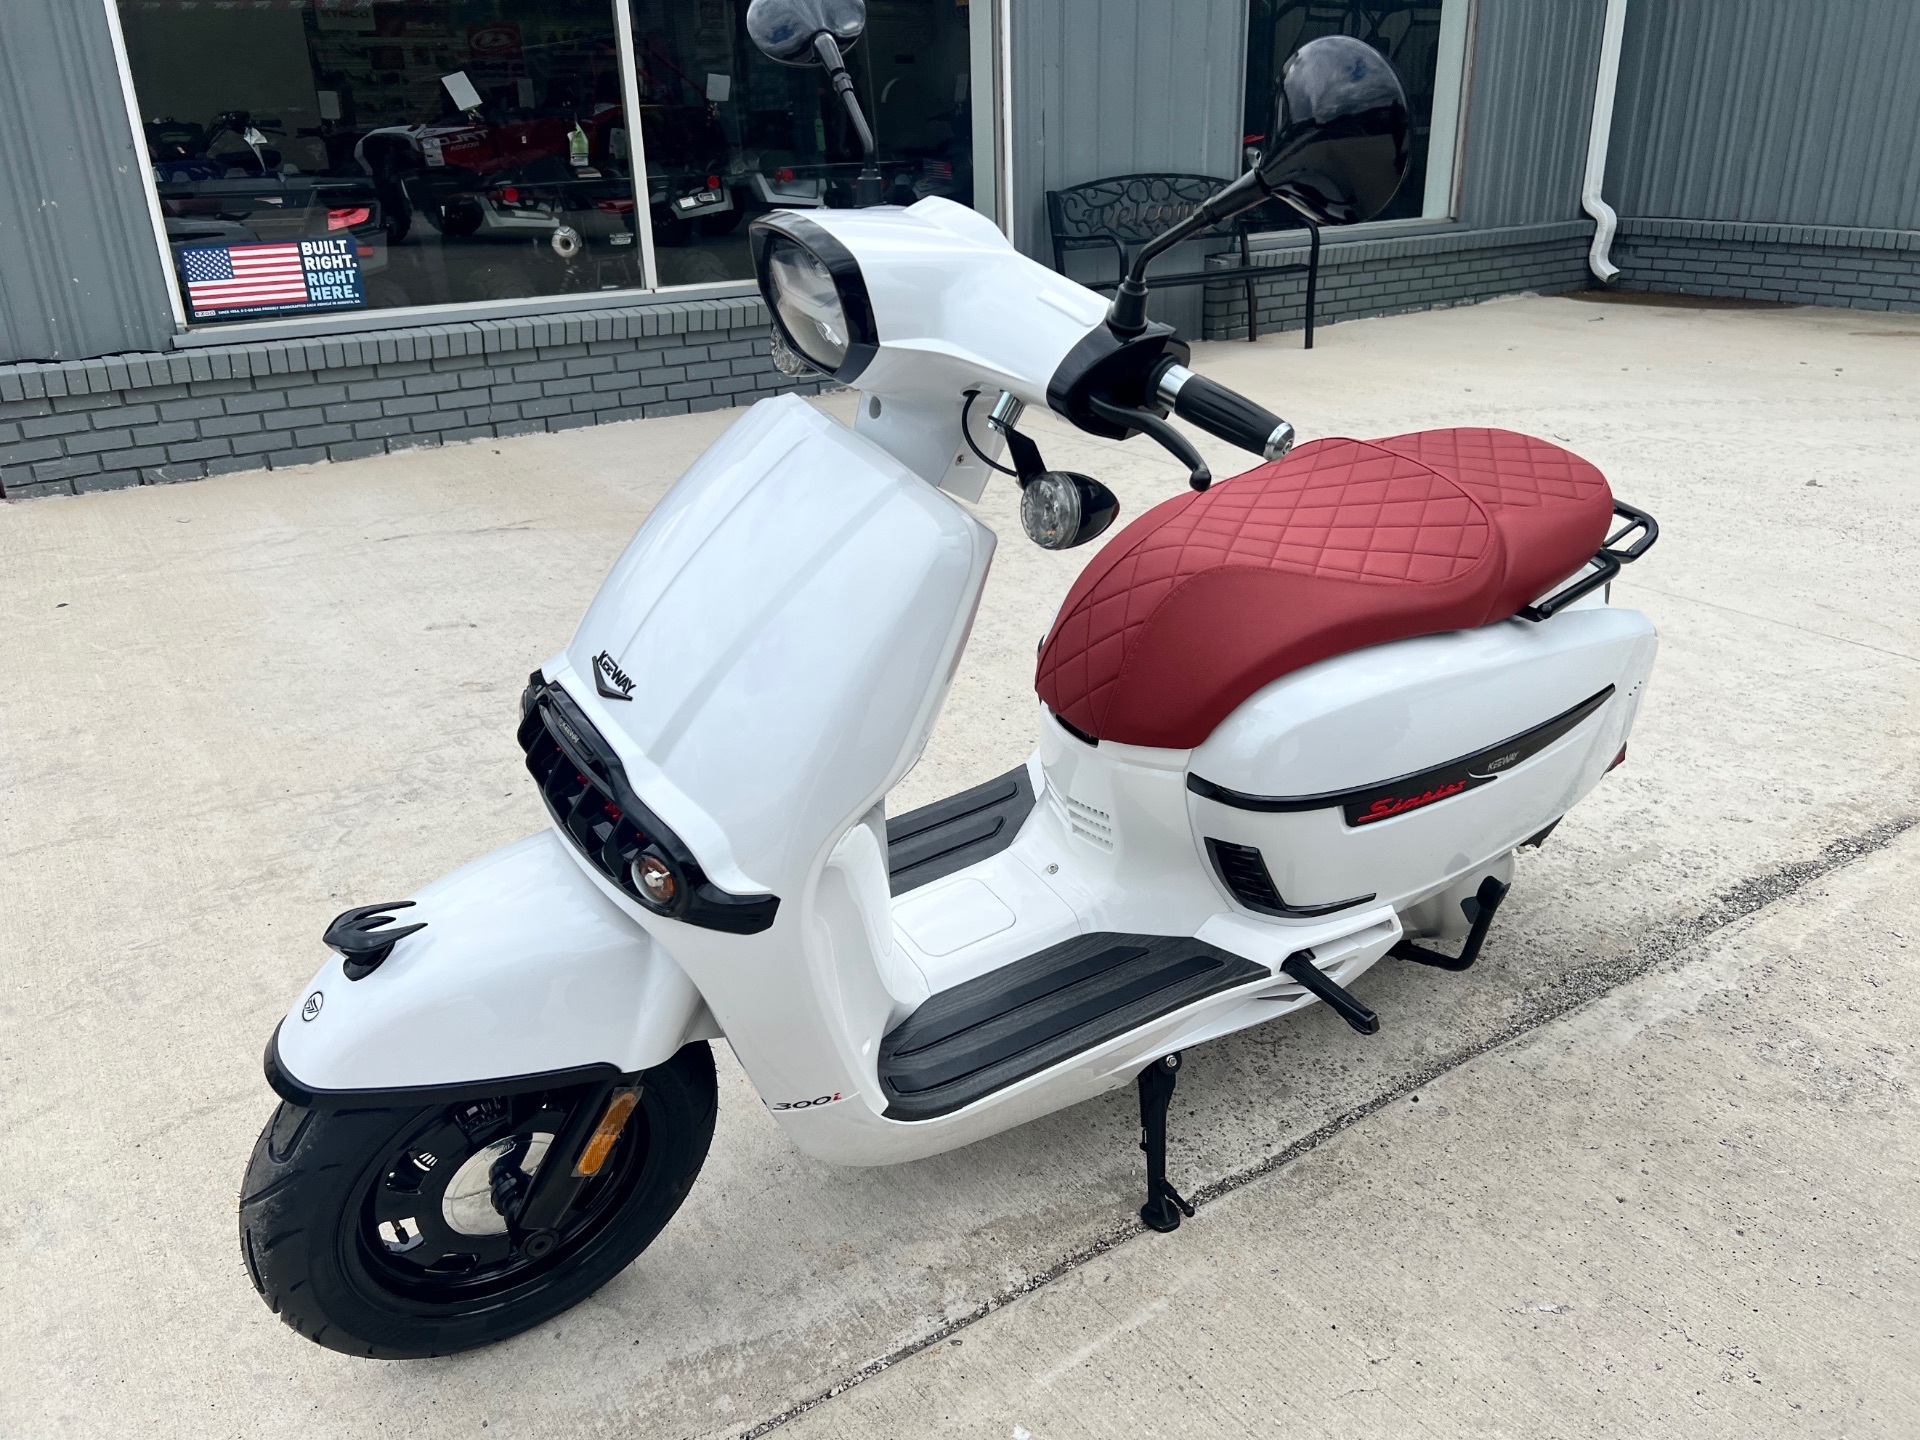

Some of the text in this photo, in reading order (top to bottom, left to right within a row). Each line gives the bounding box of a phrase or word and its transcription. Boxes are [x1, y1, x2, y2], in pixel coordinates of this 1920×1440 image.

[301, 239, 347, 256] BUILT
[303, 254, 357, 271] RIGHT.
[307, 269, 356, 286] RIGHT
[310, 284, 360, 301] HERE.
[1487, 751, 1520, 771] KEEWAY
[773, 1092, 842, 1111] 300i
